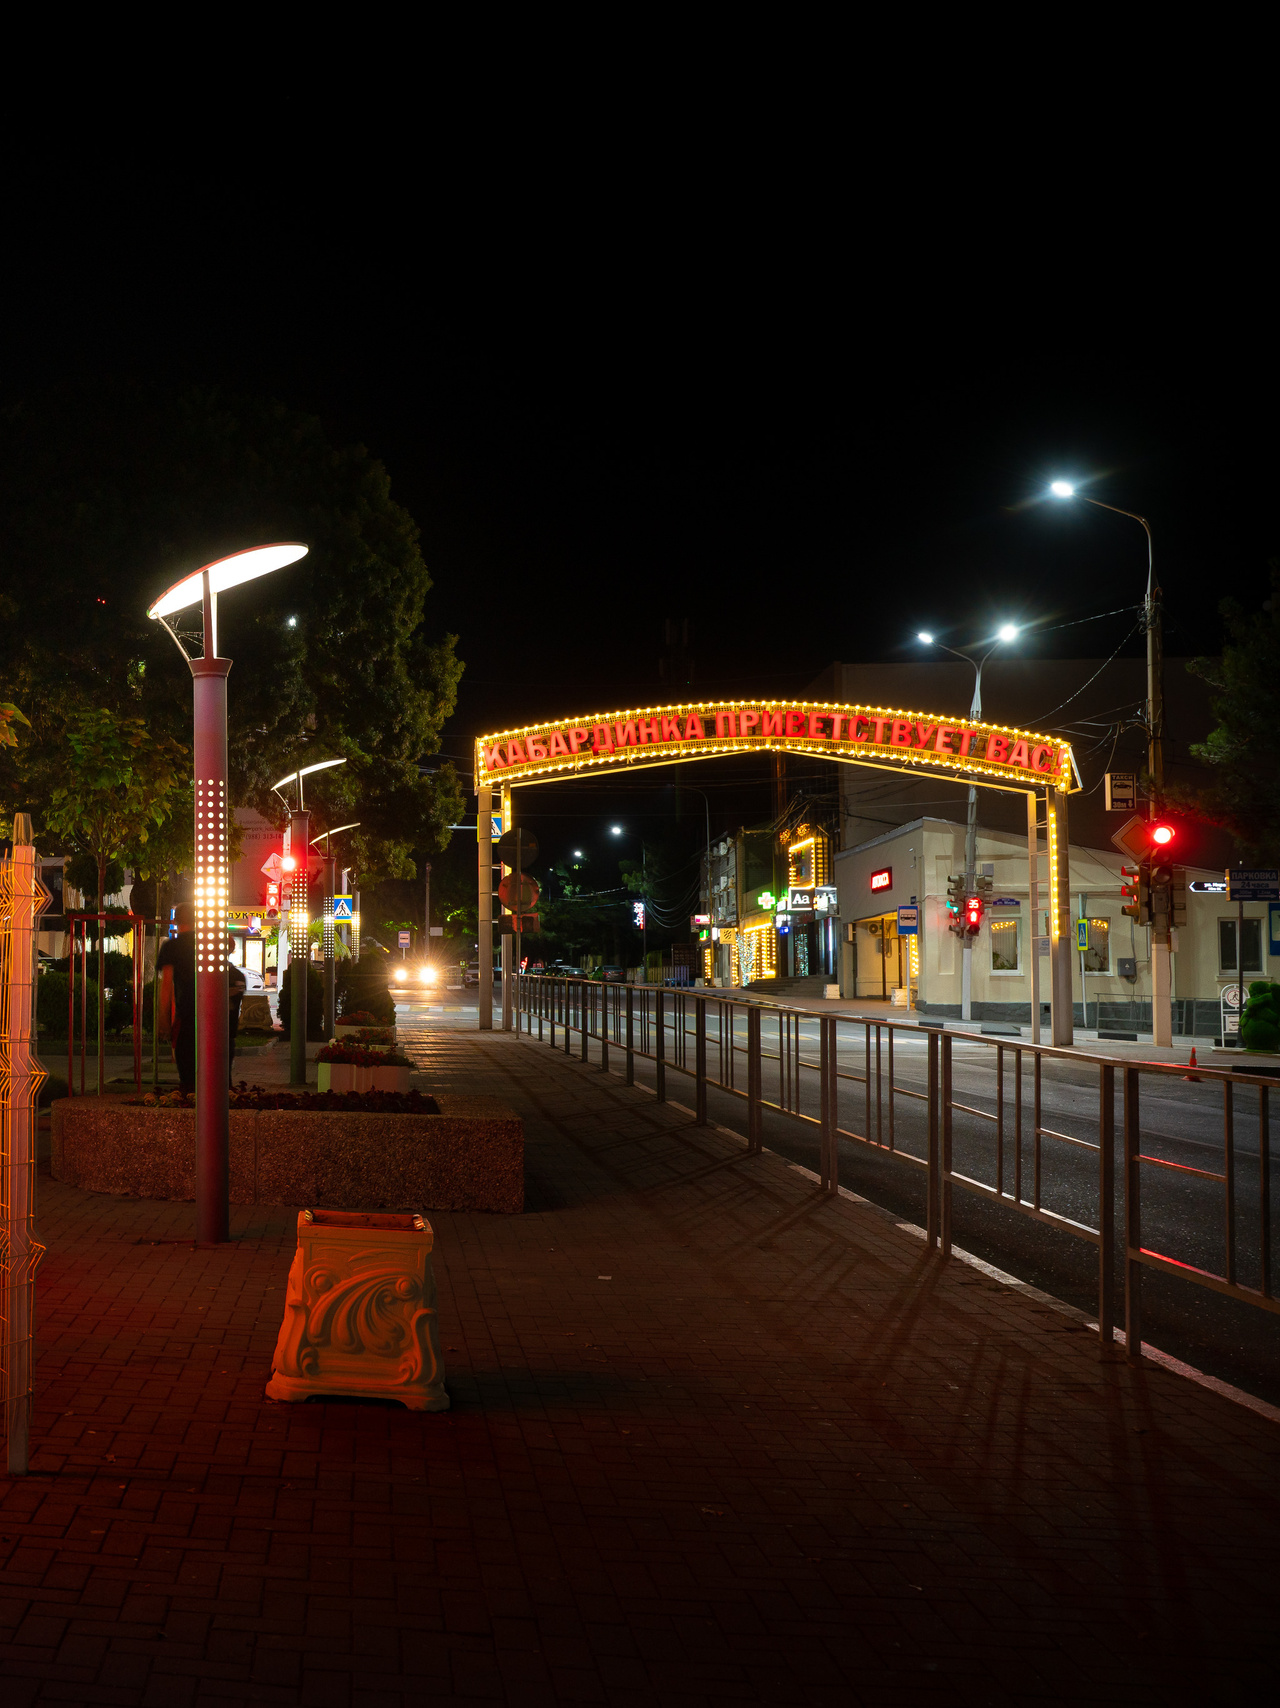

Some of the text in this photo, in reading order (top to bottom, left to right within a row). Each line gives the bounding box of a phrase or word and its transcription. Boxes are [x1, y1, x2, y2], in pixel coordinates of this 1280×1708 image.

[483, 709, 1066, 774] КАБАРДИНКА ПРИВЕТСТВУЕТ ВАС!
[1231, 871, 1277, 880] ПАРКОВКА
[792, 893, 810, 904] Aa
[968, 899, 979, 909] 35
